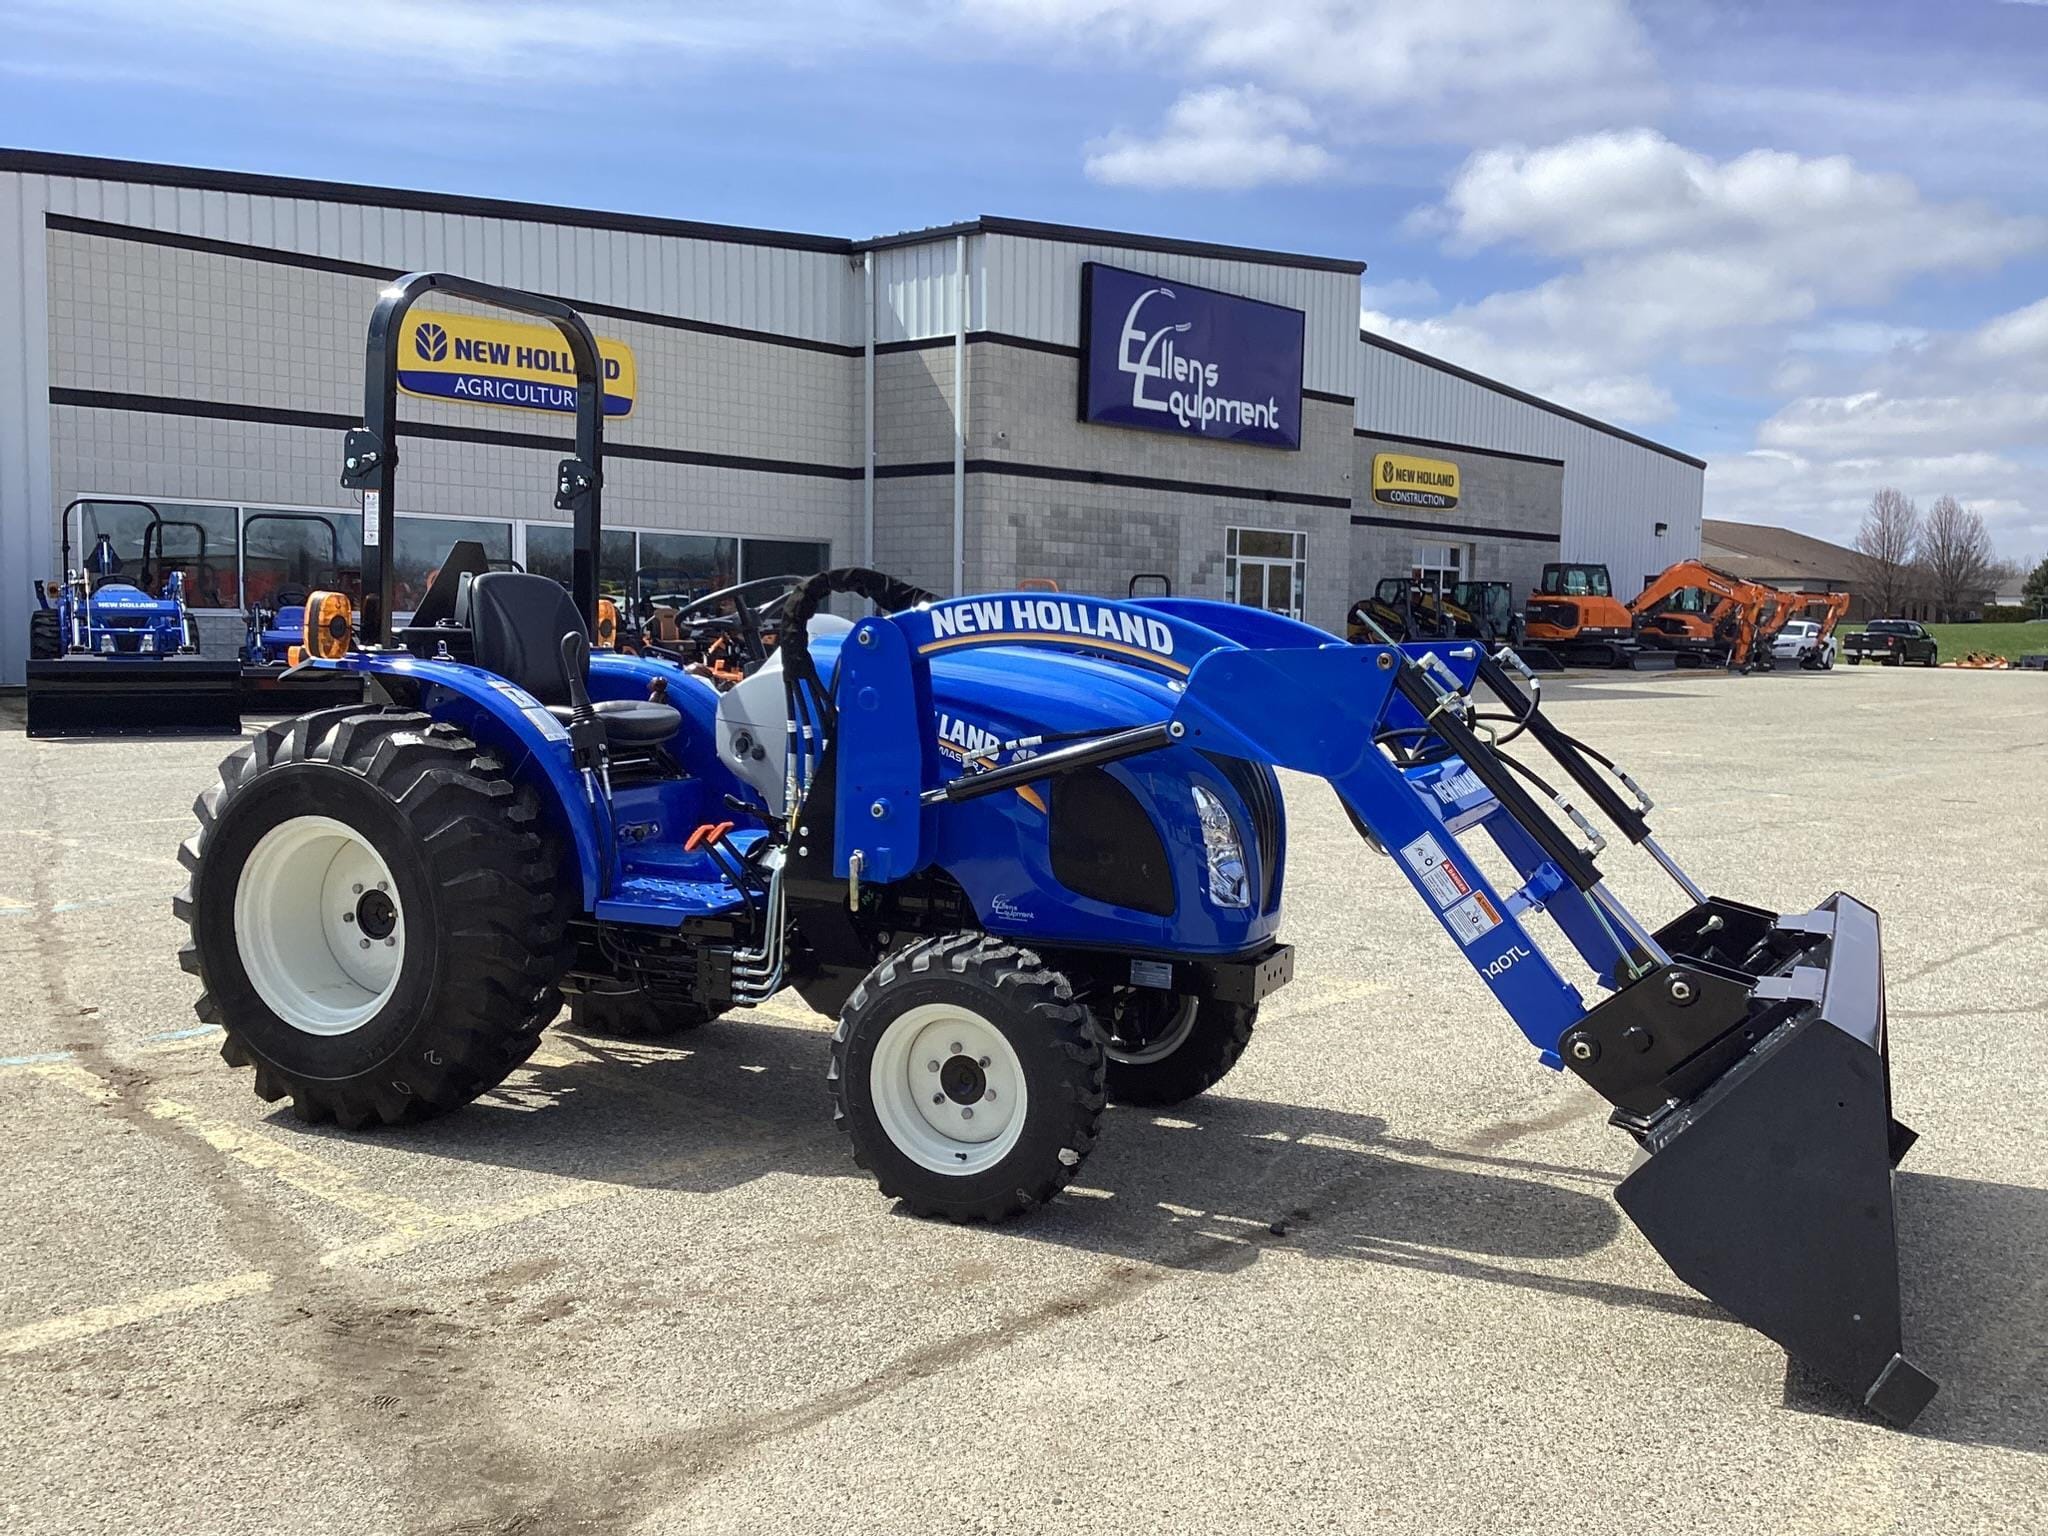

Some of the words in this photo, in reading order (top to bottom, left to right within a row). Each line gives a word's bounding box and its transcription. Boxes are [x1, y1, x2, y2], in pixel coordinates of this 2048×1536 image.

[454, 337, 510, 366] NEW
[516, 345, 621, 380] HOLLD
[1119, 288, 1219, 387] Ellens
[454, 377, 578, 408] AGRICULTUR
[1133, 325, 1280, 430] Equipment
[1390, 490, 1445, 506] CONSTRUCTION
[1395, 468, 1415, 483] NEW
[1417, 471, 1454, 488] HOLLAND
[930, 601, 1003, 639] NEW
[1011, 600, 1174, 656] HOLLAND
[935, 711, 1000, 761] LAND
[1482, 945, 1530, 980] 140TL
